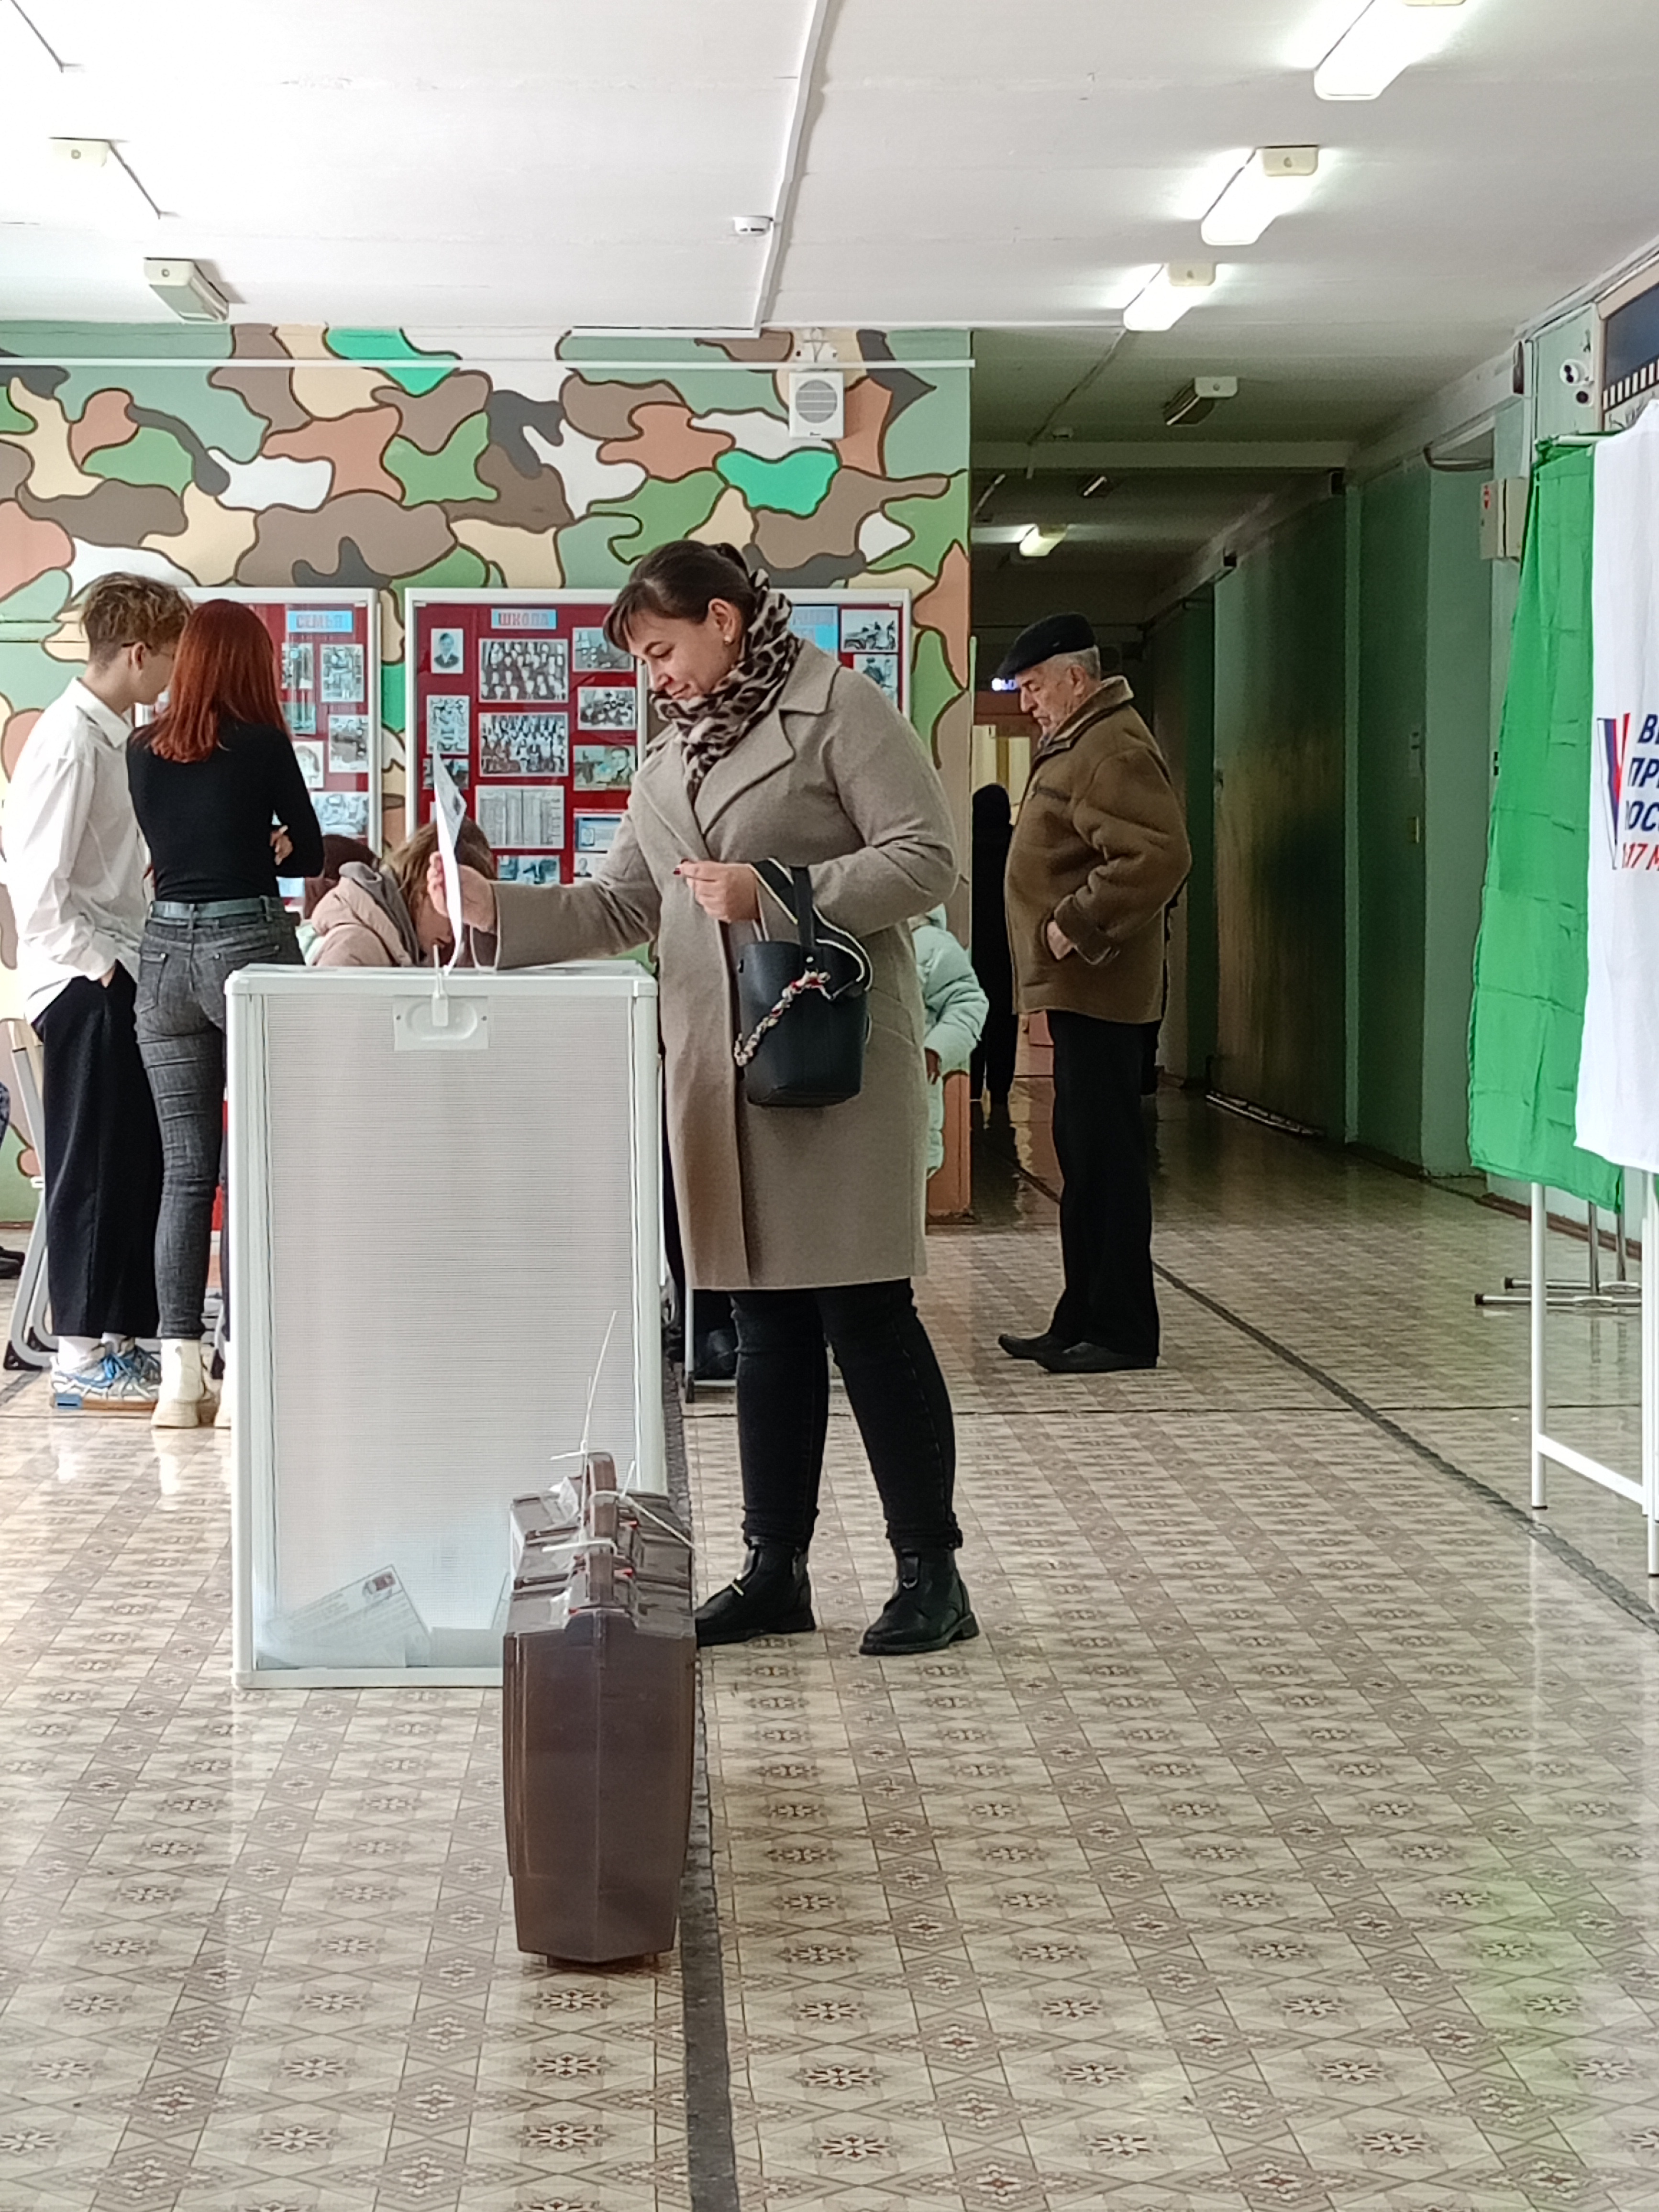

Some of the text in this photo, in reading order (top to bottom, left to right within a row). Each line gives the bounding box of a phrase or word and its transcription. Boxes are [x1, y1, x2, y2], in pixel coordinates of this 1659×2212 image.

[1637, 714, 1659, 744] В
[1627, 757, 1659, 787] ПР
[1625, 800, 1659, 831] ОС
